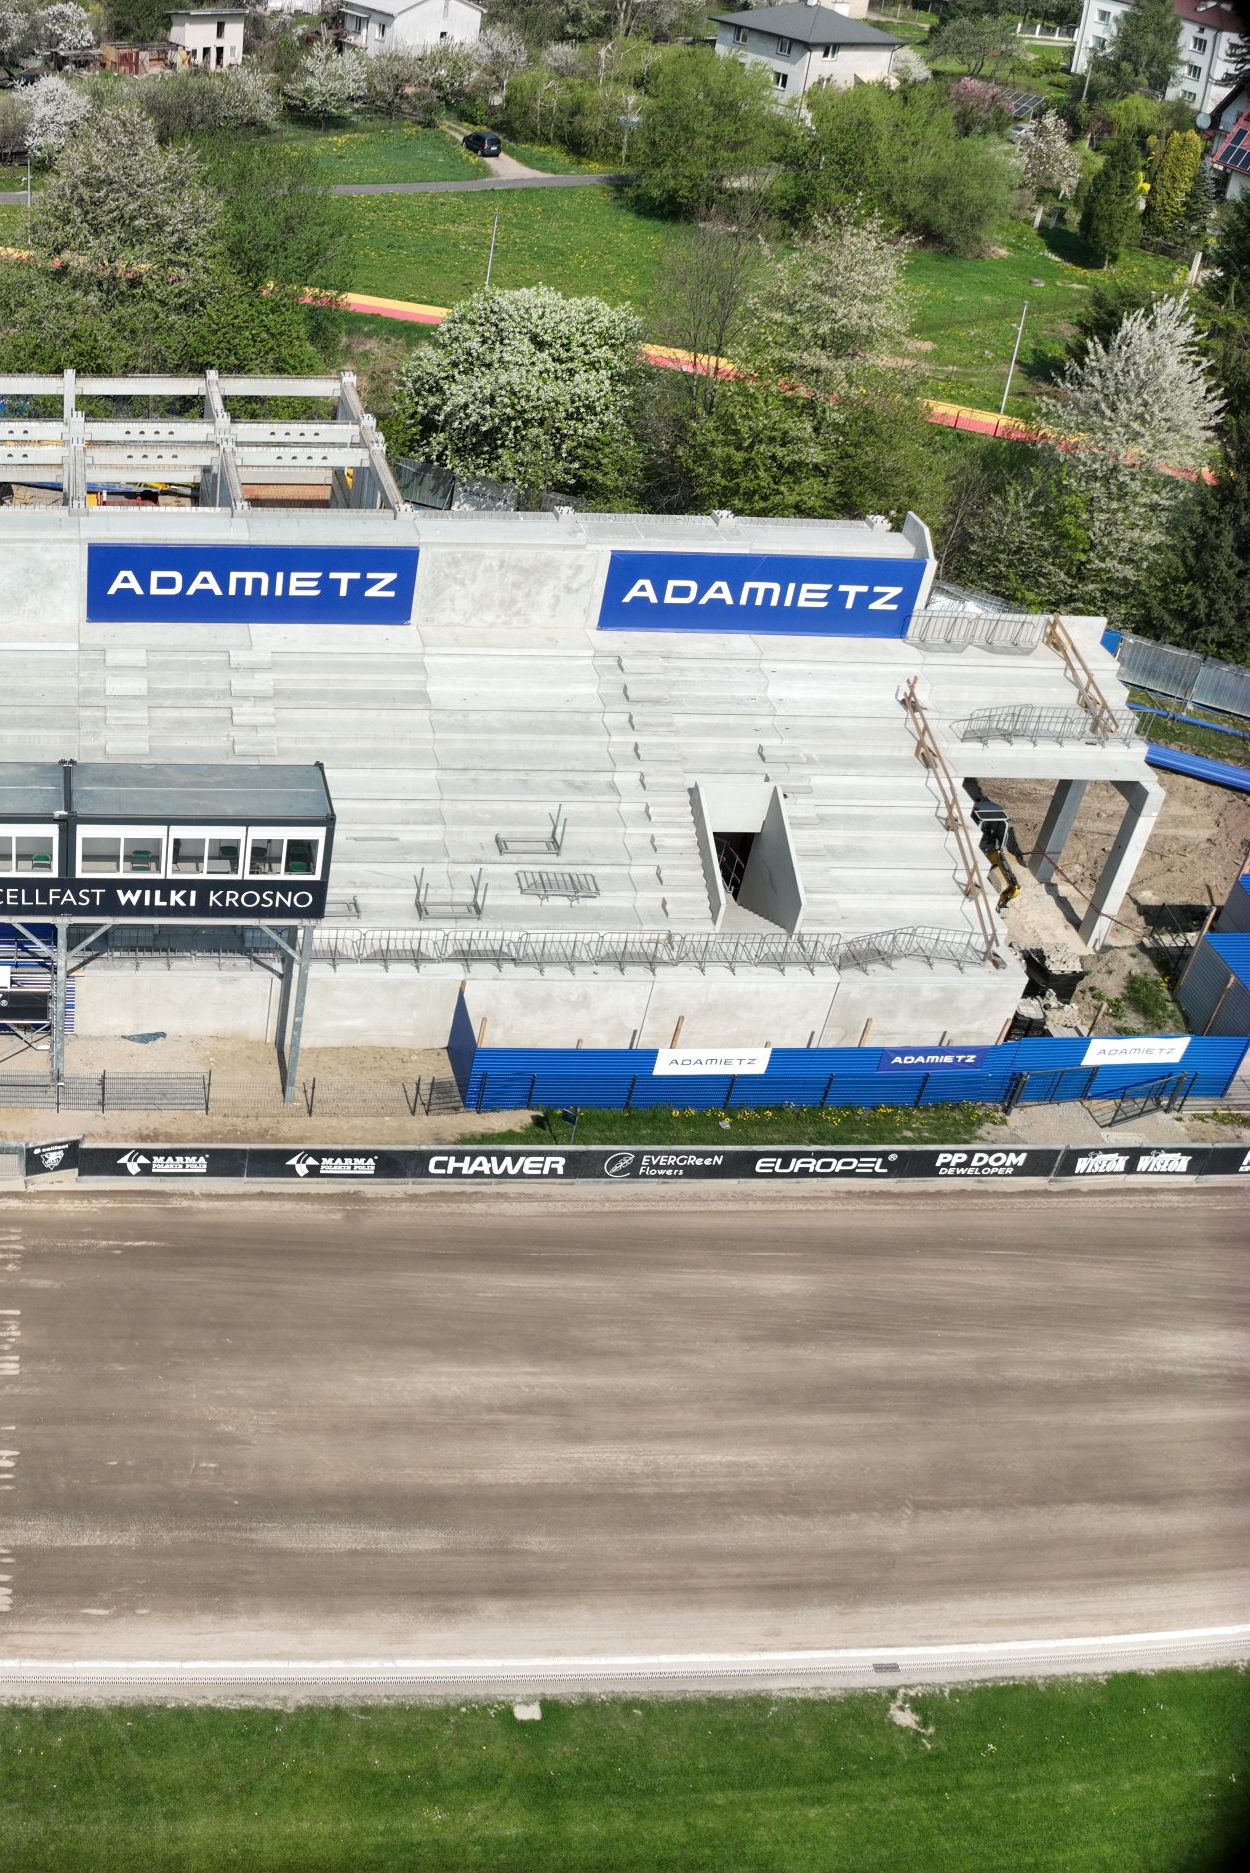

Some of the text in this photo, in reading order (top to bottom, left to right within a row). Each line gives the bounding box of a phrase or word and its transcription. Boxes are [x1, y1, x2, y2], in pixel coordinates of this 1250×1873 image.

[107, 570, 397, 597] ADAMIETZ
[622, 578, 903, 610] ADAMIETZ
[117, 889, 197, 906] WILKI
[209, 890, 313, 907] KROSNO
[1097, 1048, 1176, 1056] ADAMIETZ
[668, 1057, 757, 1066] ADAMIETZ
[890, 1054, 977, 1064] ADAMIETZ
[321, 1157, 375, 1165] MARMA
[935, 1153, 1027, 1167] PP DOM
[428, 1156, 566, 1175] CHAWER
[639, 1166, 684, 1176] Flowers
[938, 1167, 1014, 1175] DEWELOPER
